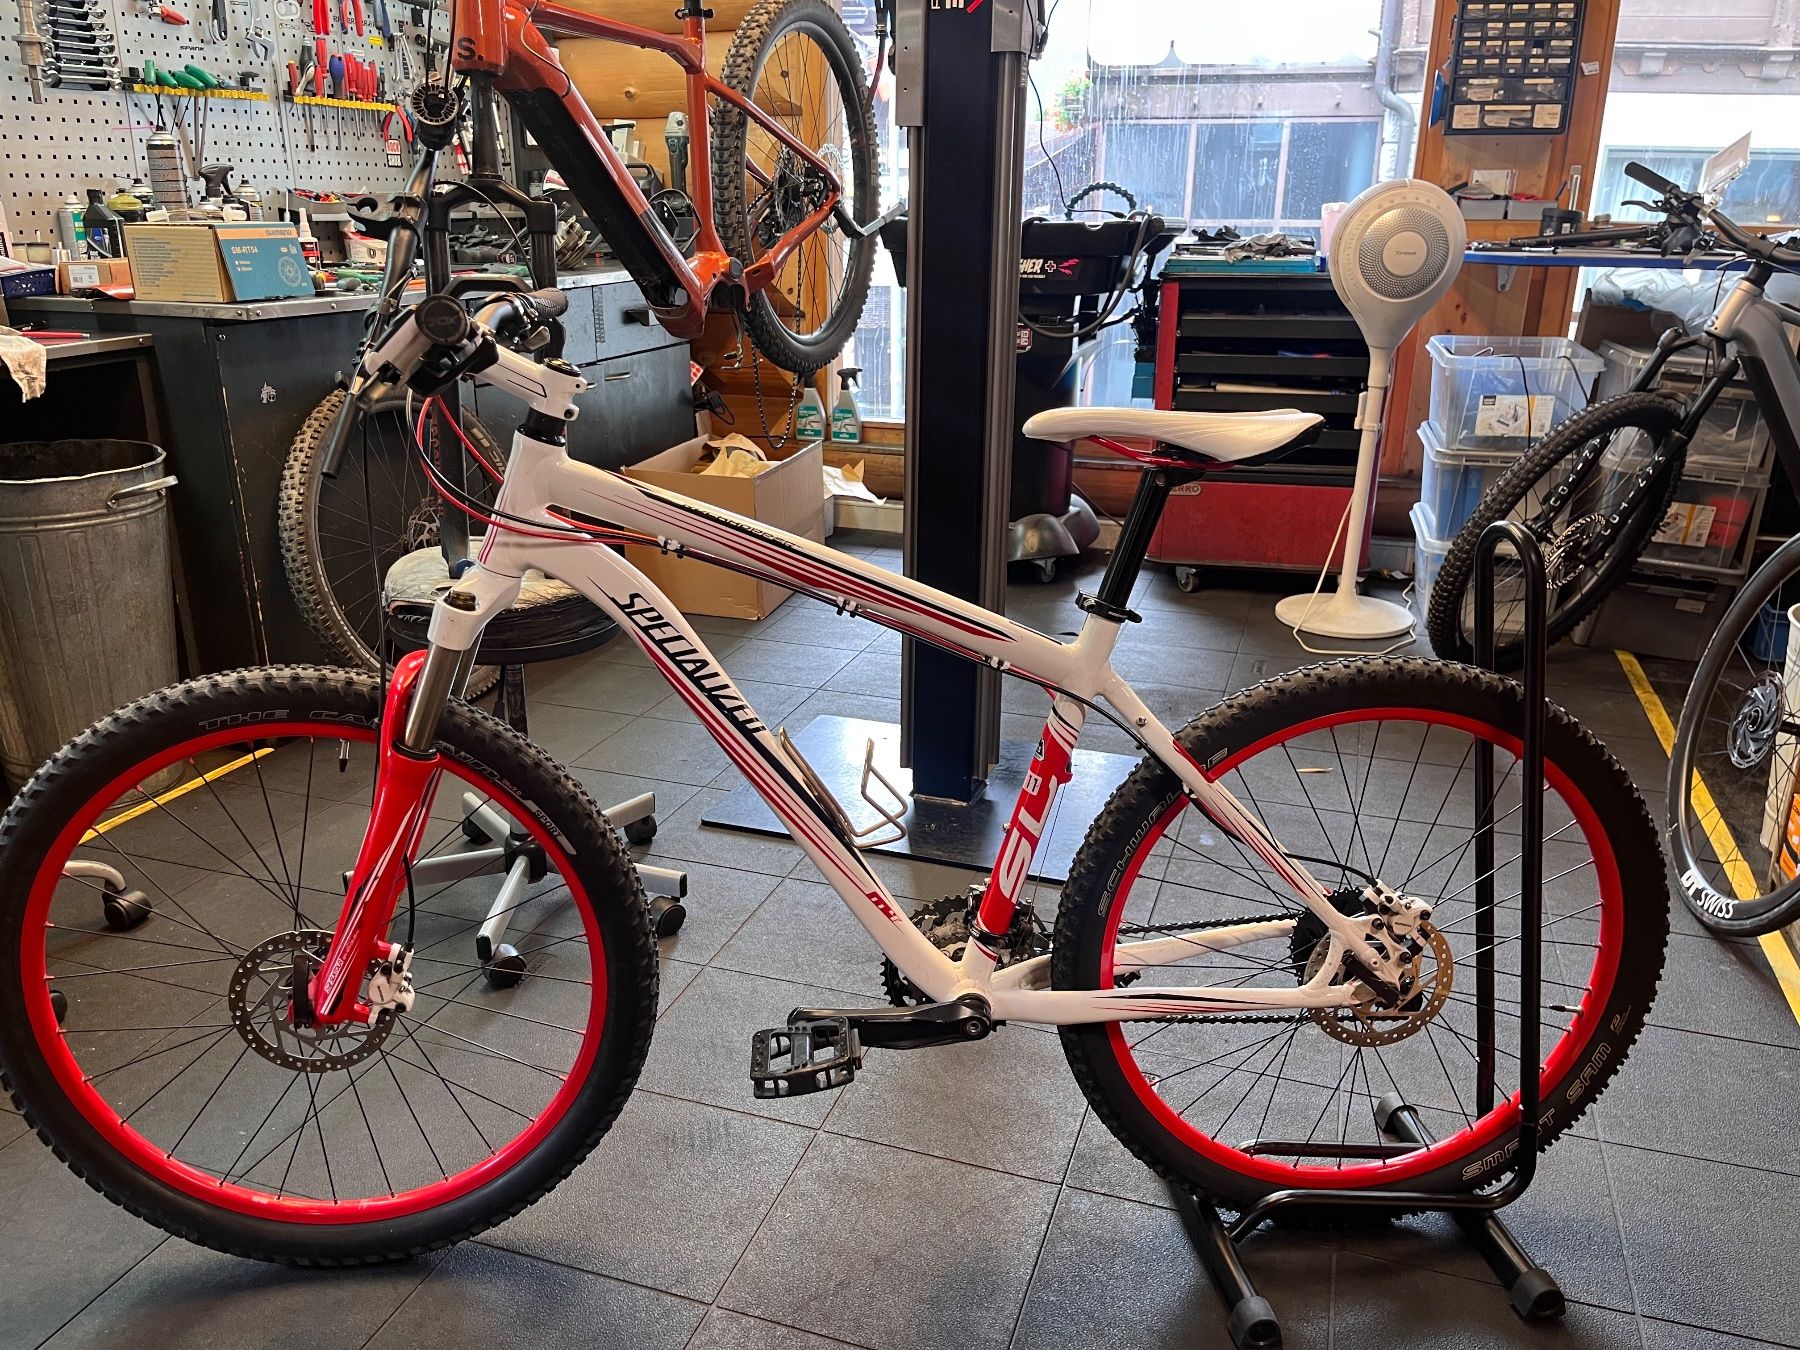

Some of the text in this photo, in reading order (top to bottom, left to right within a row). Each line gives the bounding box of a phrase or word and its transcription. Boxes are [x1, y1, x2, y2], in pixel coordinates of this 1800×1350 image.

[199, 709, 290, 730] THE
[534, 809, 564, 839] SPORT
[999, 774, 1058, 905] SL
[1680, 869, 1740, 919] DT SWISS
[1566, 1042, 1612, 1105] SAM
